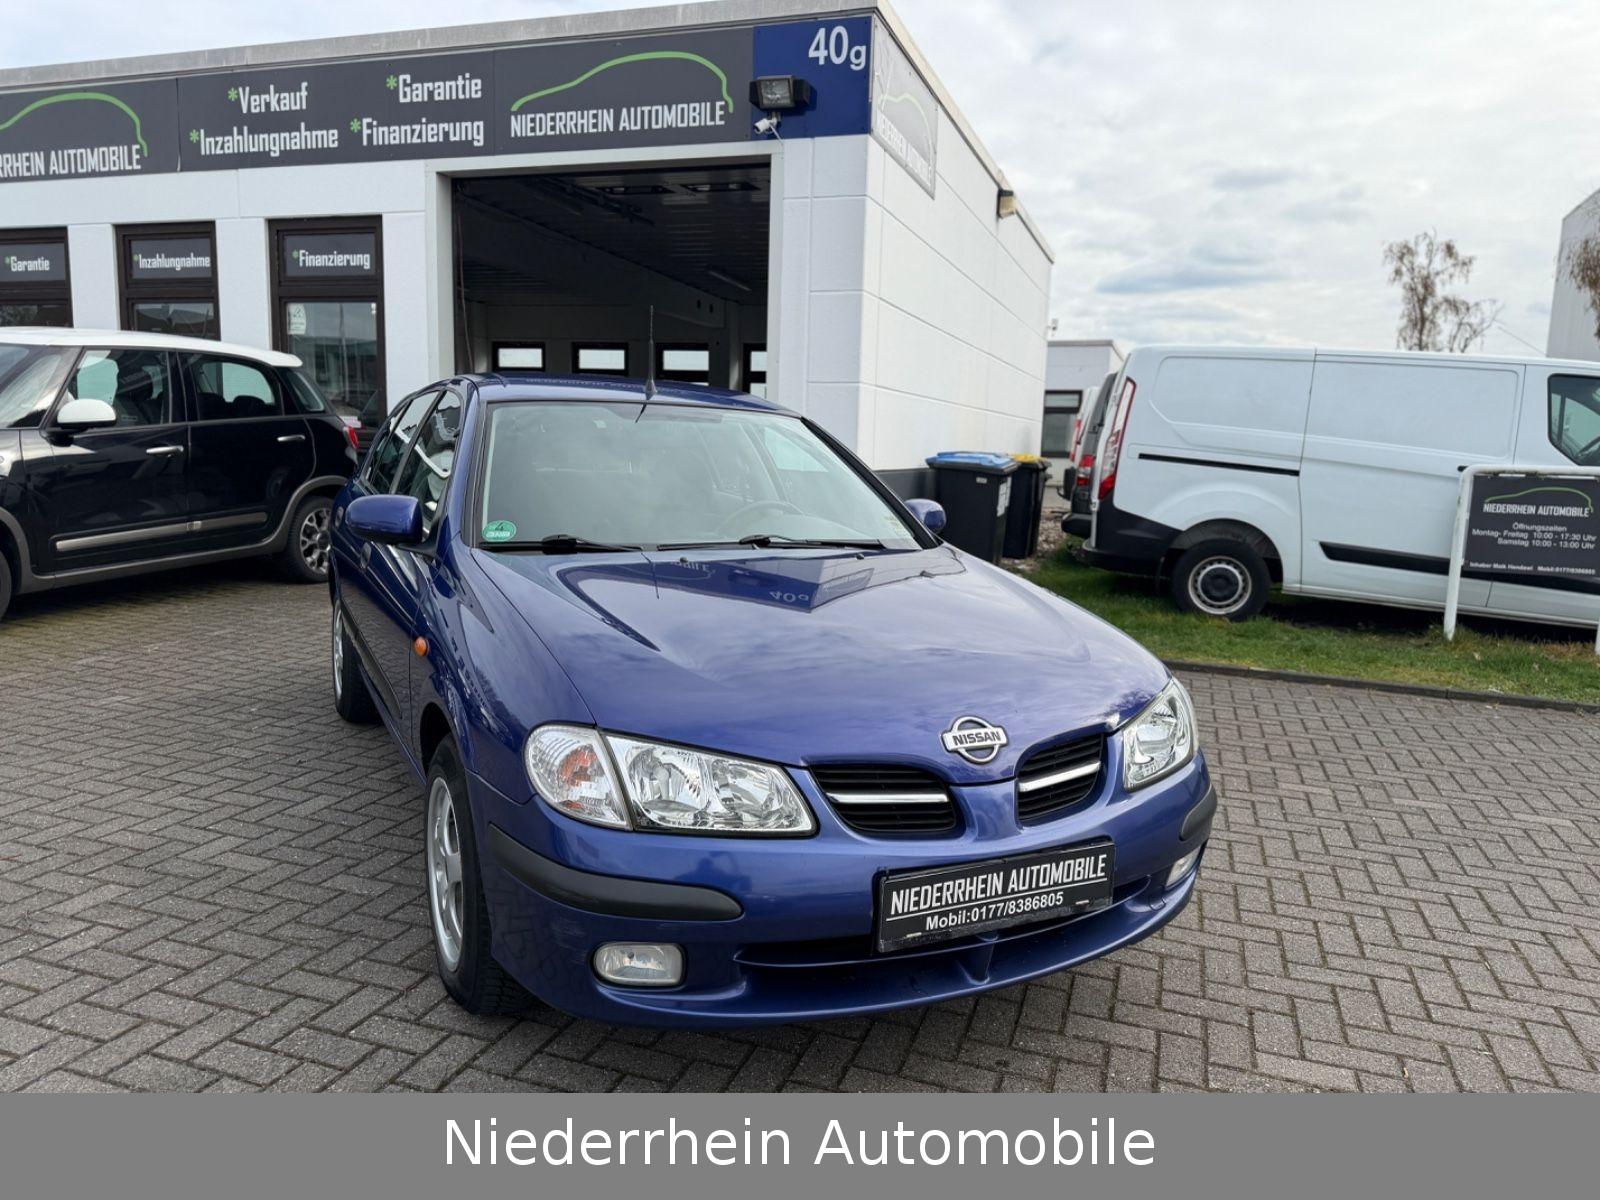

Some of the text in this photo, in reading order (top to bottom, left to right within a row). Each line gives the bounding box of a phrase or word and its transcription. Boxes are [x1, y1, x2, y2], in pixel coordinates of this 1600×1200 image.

[808, 26, 867, 70] 40g
[238, 82, 308, 114] Verkauf
[399, 73, 482, 103] Garantie
[362, 117, 484, 147] Finanzierung
[510, 101, 725, 138] NIEDERRHEIN AUTOMOBILE
[200, 122, 339, 157] Inzahlungnahme
[49, 144, 142, 175] AUTOMOBILE
[10, 256, 51, 272] Garantie
[139, 253, 211, 271] Inzahlungnahme
[299, 249, 371, 271] Finanzierung
[1483, 503, 1590, 518] NIEDERRHEIN AUTOMOBILE
[1512, 522, 1567, 532] Öffnungszeiten
[1582, 533, 1597, 541] Uhr
[1497, 537, 1530, 547] Samstag
[1581, 542, 1596, 550] Uhr
[952, 731, 1001, 746] NISSAN
[890, 853, 1108, 916] NIEDERRHEIN AUTOMOBILE
[925, 891, 1065, 931] Mobil:0177/8386805
